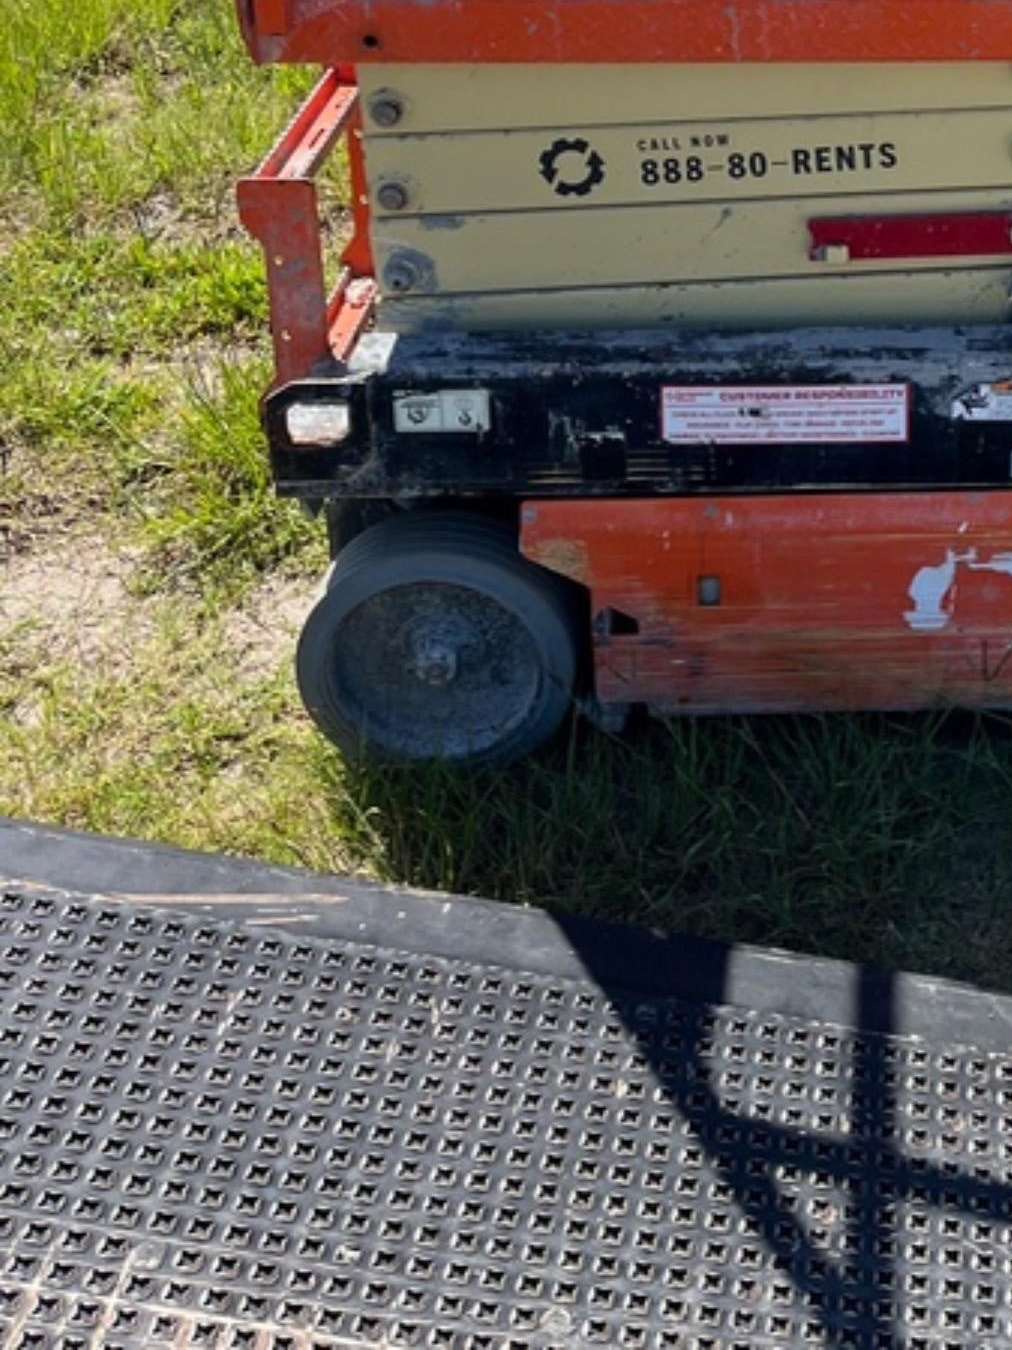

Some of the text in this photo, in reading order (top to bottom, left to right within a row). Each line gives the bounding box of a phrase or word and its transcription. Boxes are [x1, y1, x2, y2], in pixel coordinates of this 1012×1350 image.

[636, 134, 729, 152] CALL NOW
[640, 141, 898, 186] 888-80-RENTS
